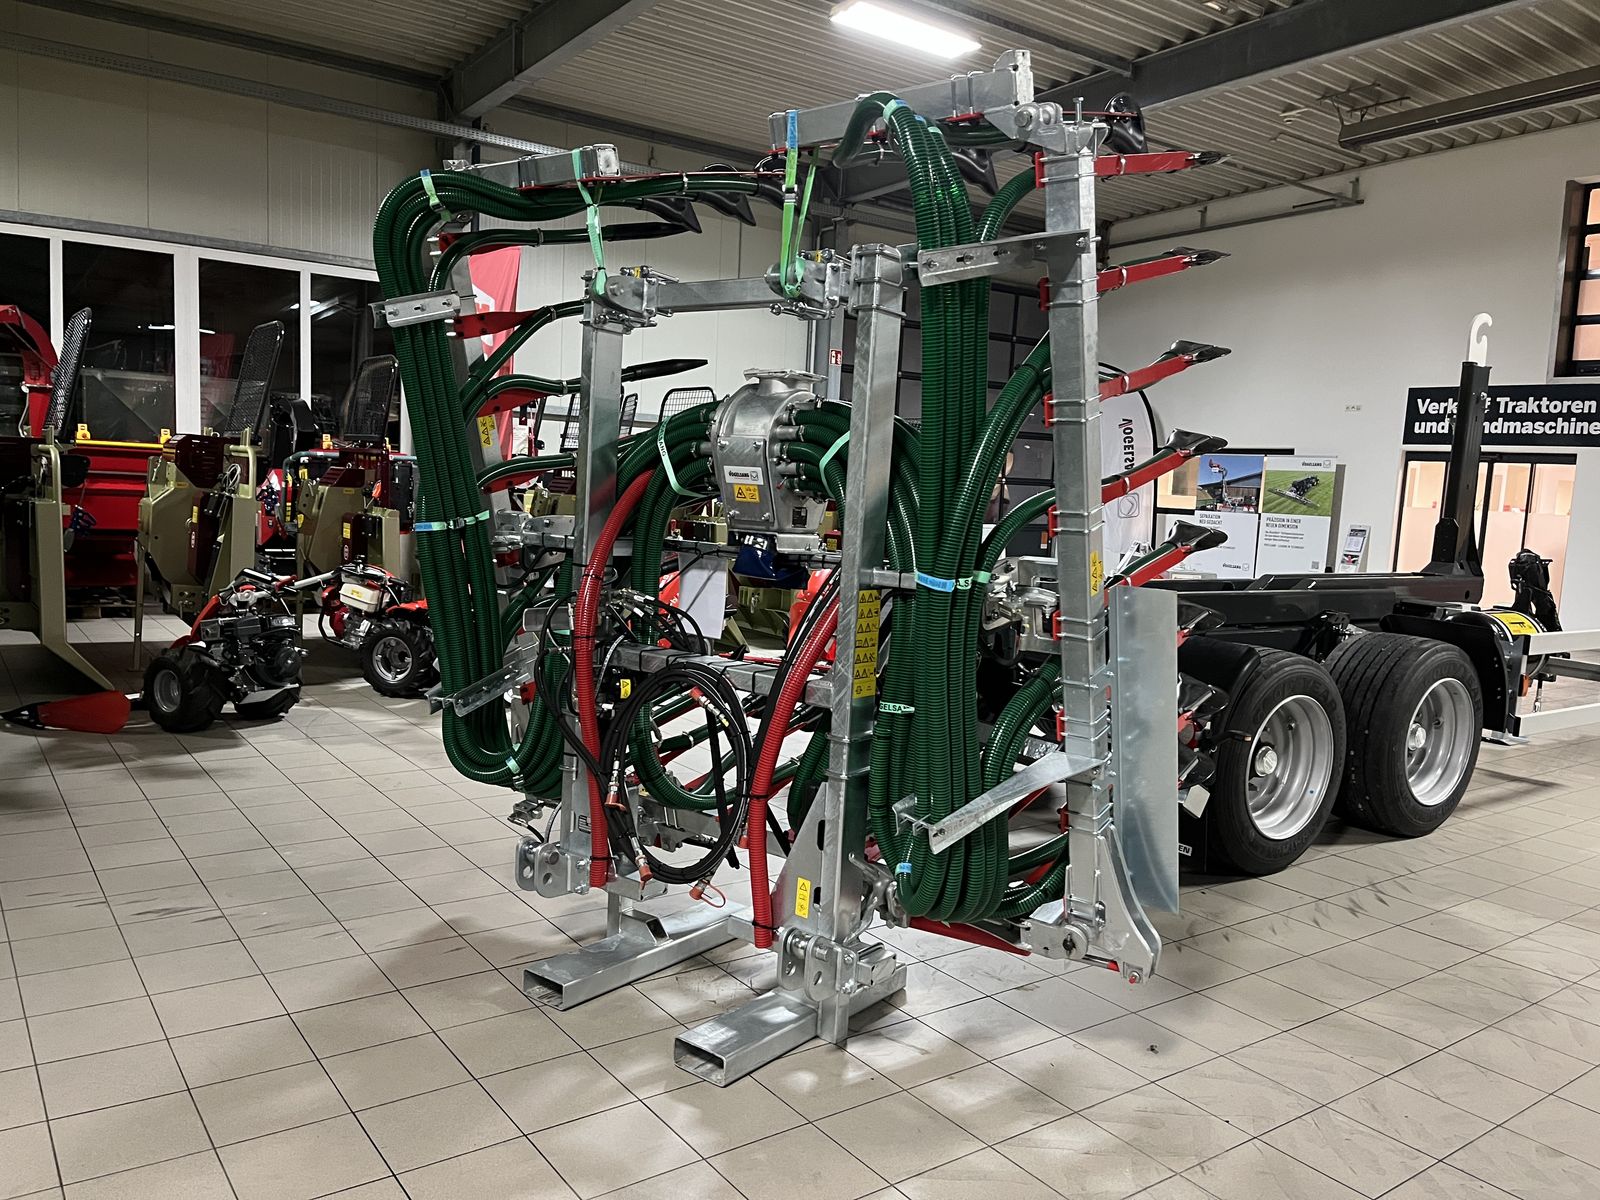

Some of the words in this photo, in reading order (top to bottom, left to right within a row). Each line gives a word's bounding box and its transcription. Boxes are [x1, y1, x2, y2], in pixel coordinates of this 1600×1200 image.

[1417, 398, 1491, 414] Verkf
[1497, 397, 1597, 414] Traktoren
[1414, 418, 1449, 434] und
[1453, 417, 1600, 435] ndmaschine
